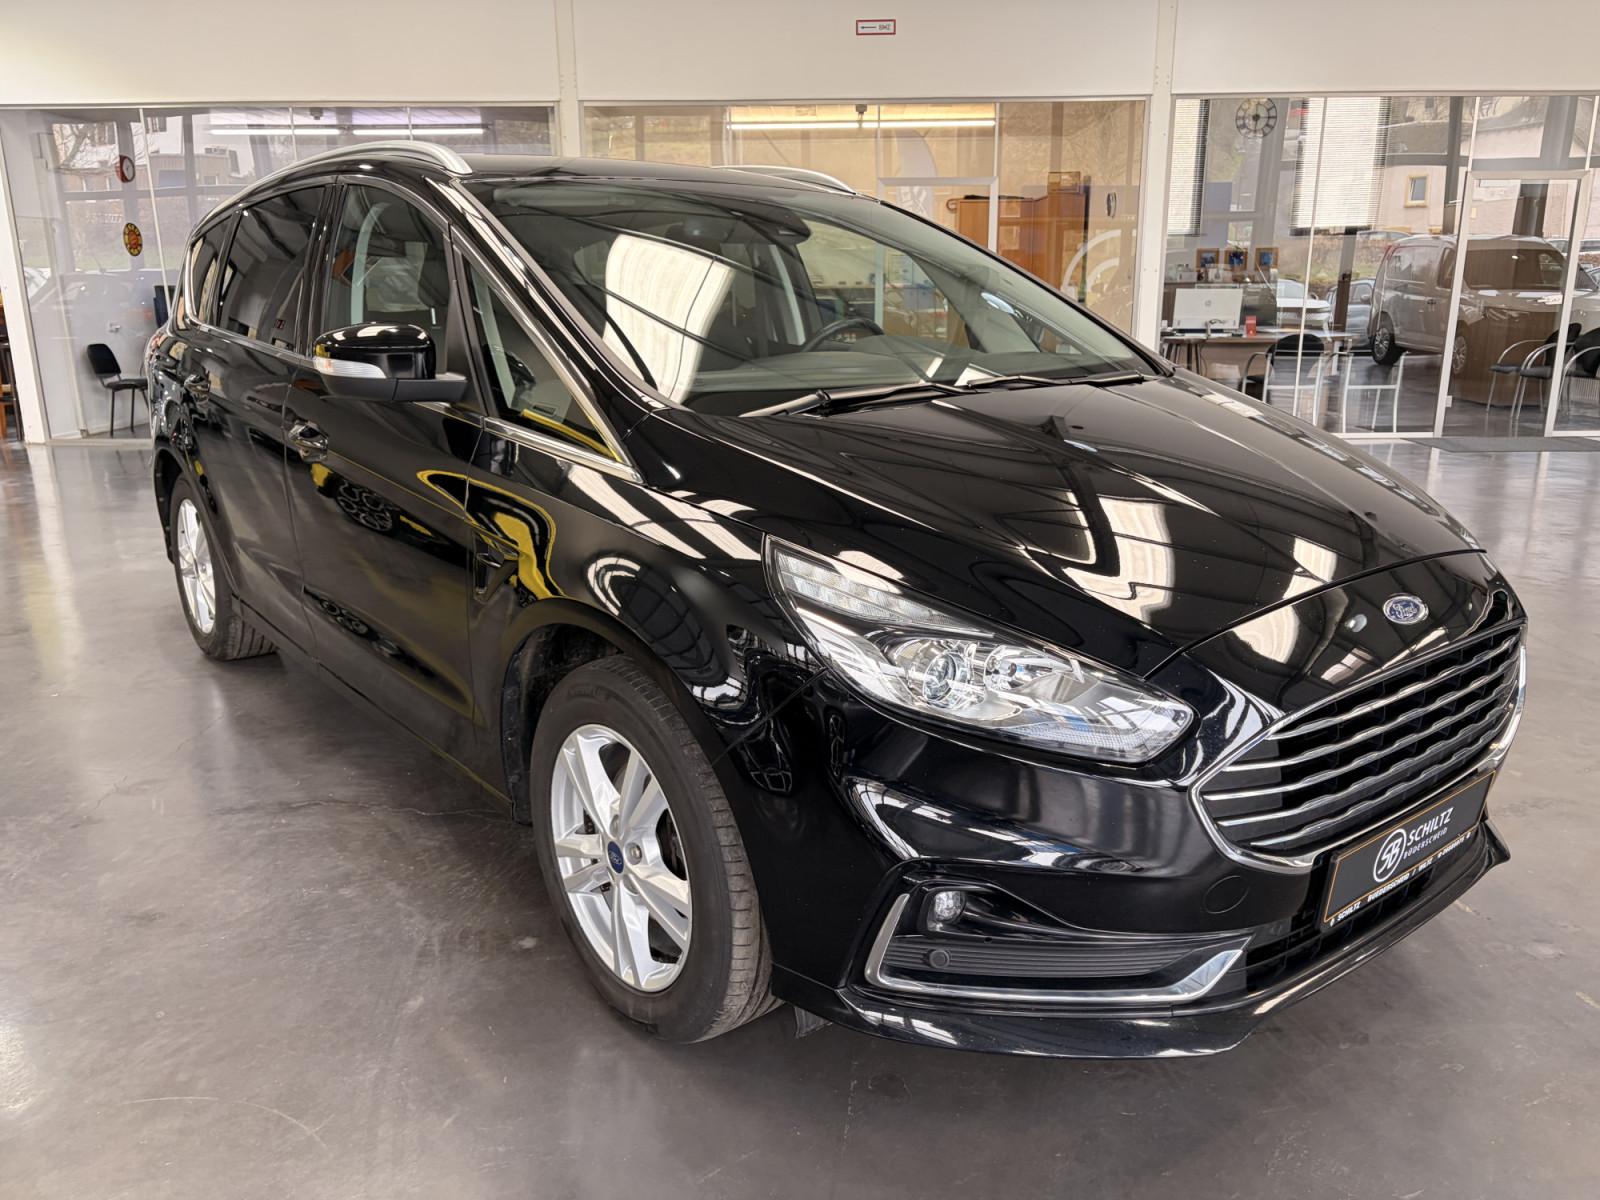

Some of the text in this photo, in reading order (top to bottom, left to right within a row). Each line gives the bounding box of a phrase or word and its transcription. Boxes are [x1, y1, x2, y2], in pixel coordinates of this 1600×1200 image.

[1392, 602, 1418, 618] Ford
[1406, 806, 1454, 847] SCHILTZ
[1376, 836, 1404, 876] SB
